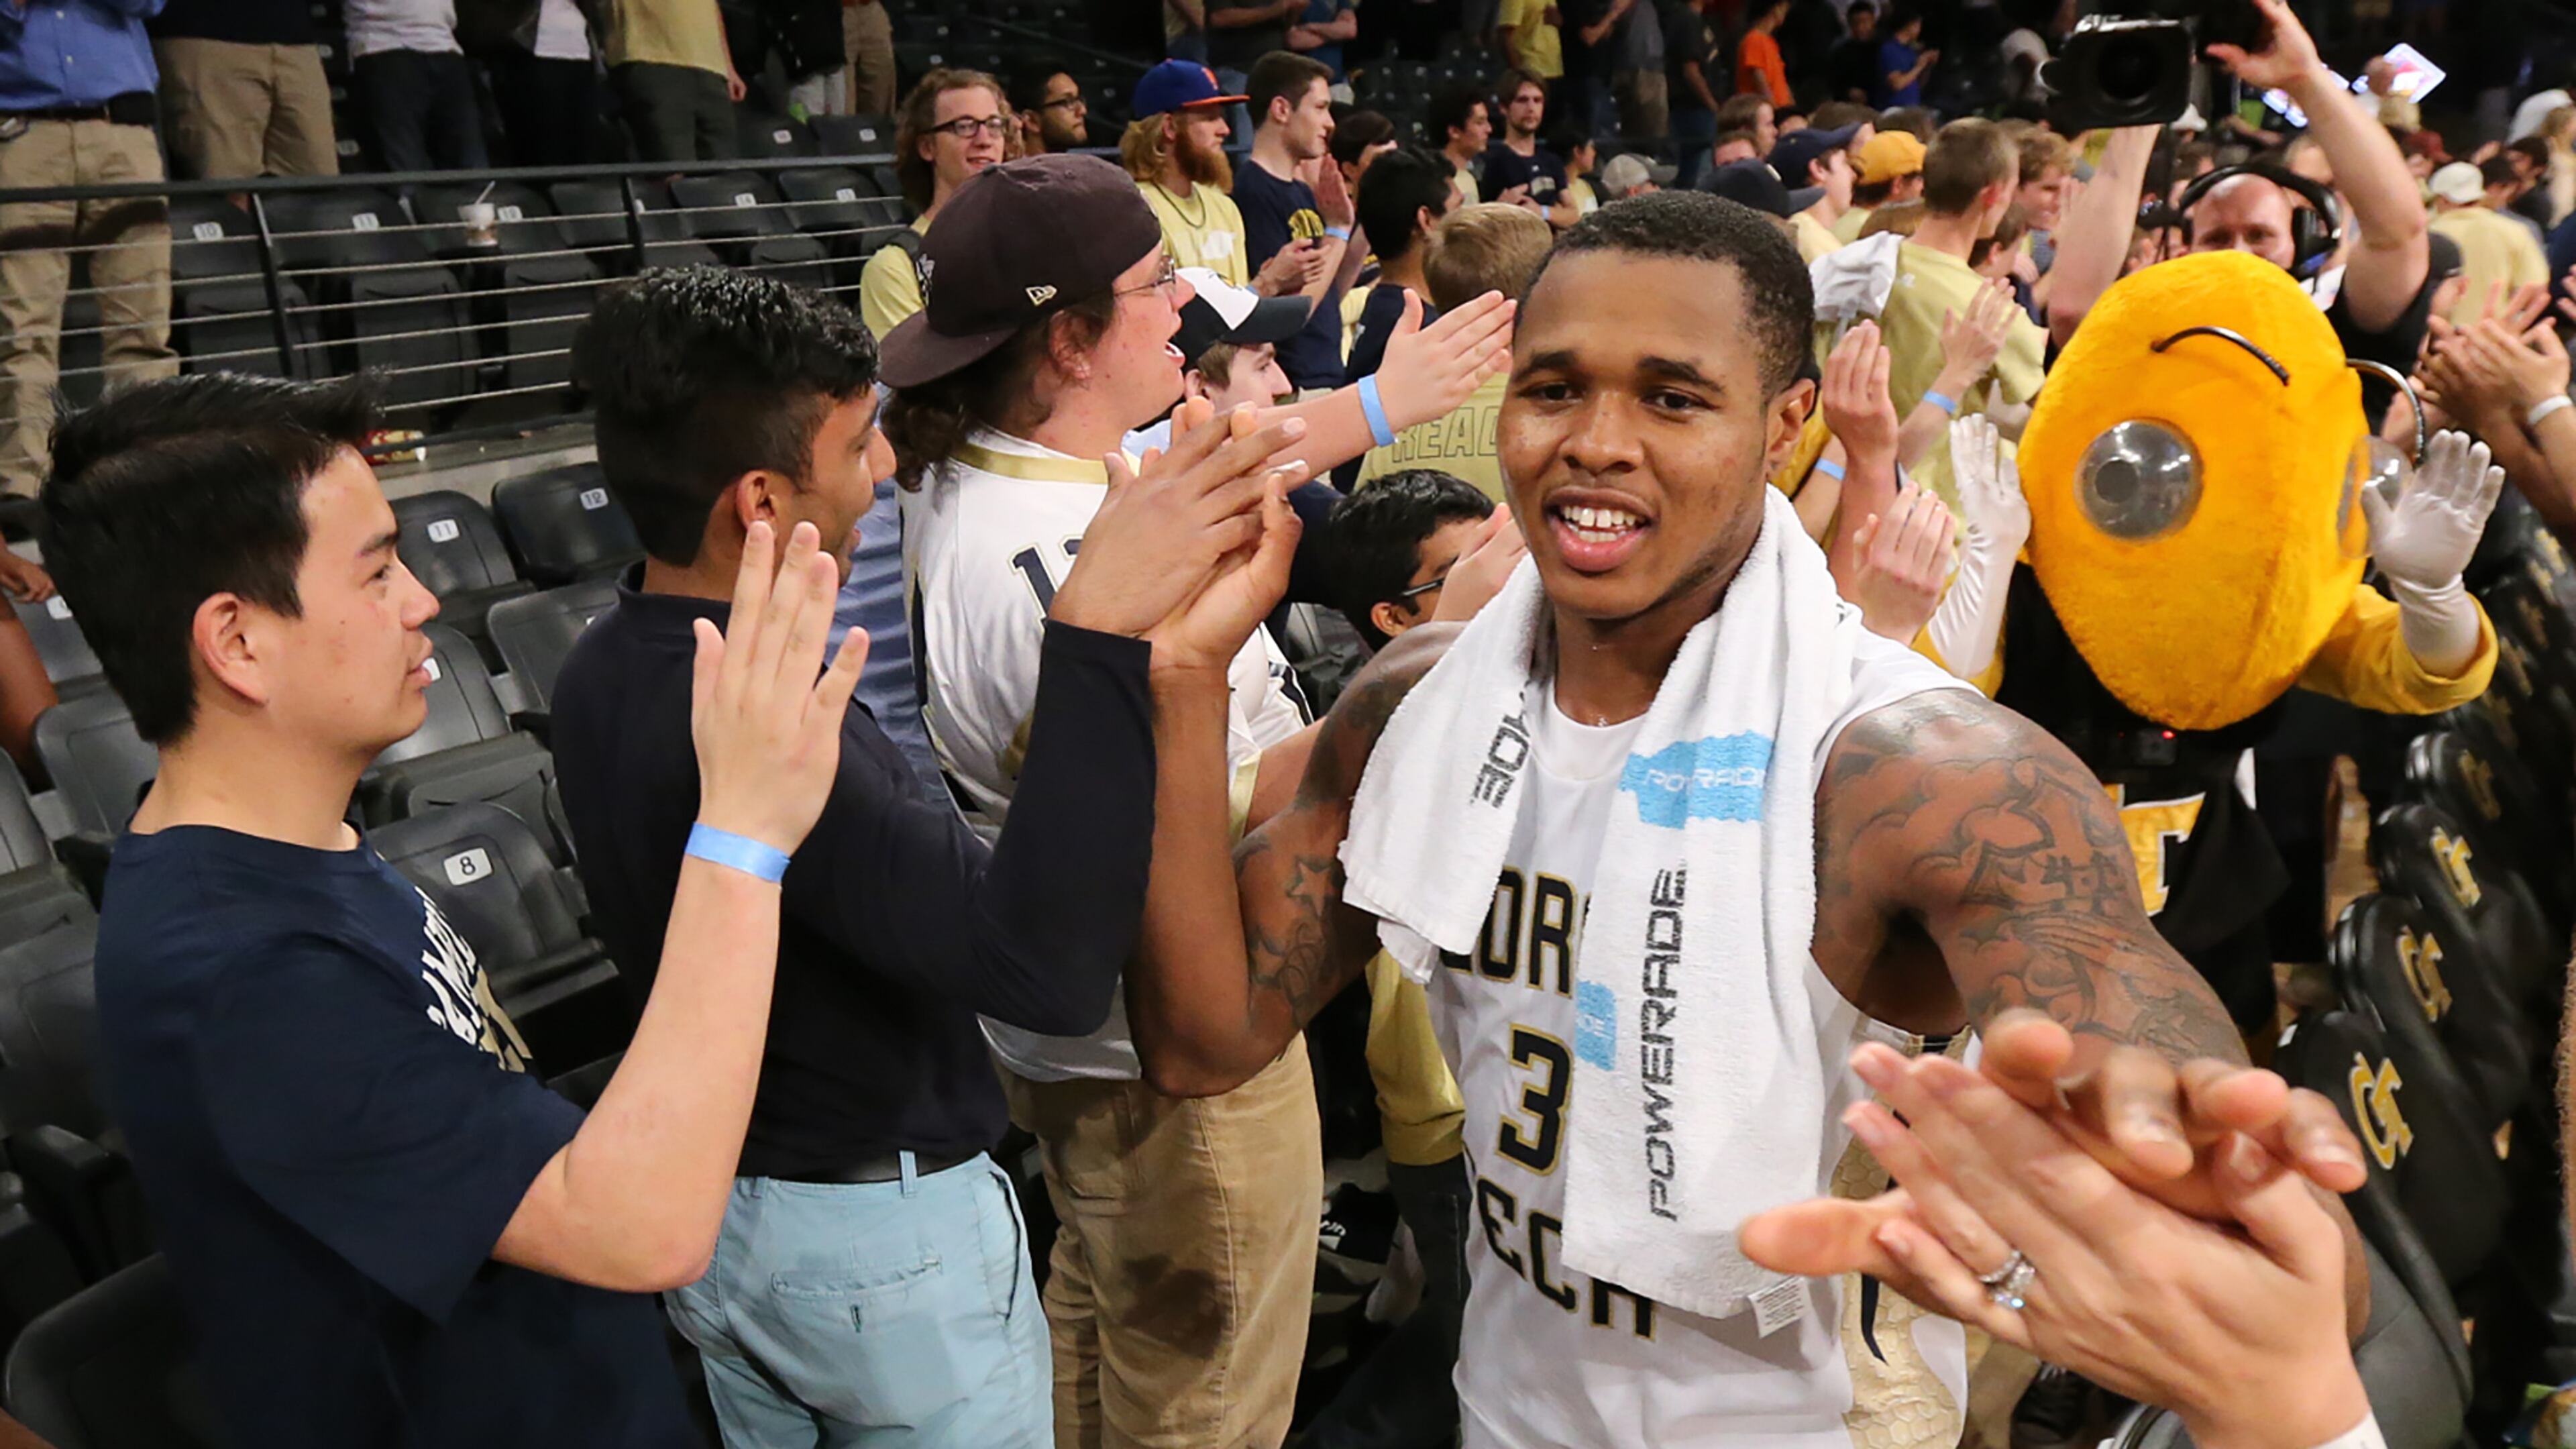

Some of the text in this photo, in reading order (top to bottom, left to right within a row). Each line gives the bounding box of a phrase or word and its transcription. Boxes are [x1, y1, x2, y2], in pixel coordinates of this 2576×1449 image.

[584, 491, 603, 506] 12
[435, 523, 453, 537] 11
[1008, 536, 1083, 627] 1
[460, 855, 476, 876] 8
[1640, 868, 1686, 1222] POWERADE
[1495, 1023, 1575, 1177] 3
